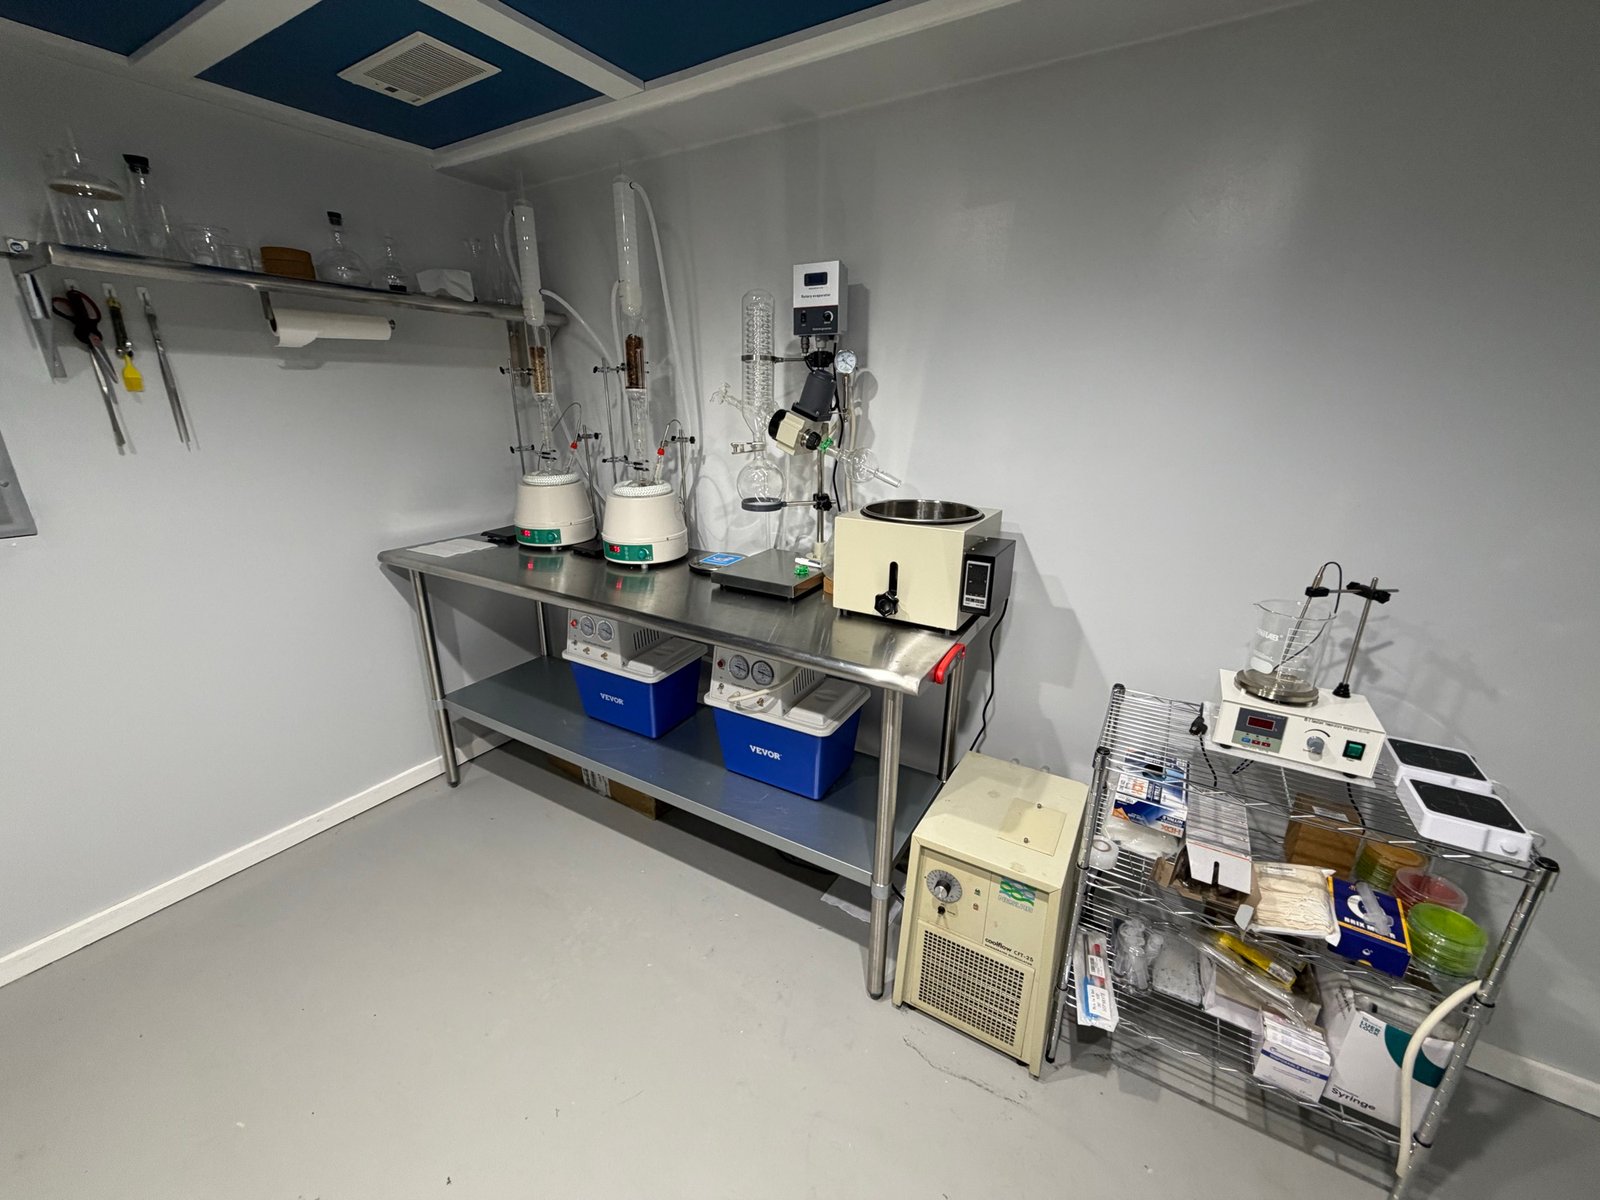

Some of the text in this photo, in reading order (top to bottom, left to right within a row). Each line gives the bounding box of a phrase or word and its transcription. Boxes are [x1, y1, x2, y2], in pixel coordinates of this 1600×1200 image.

[600, 692, 624, 705] VEVOR
[749, 744, 782, 760] VEVOR
[1161, 824, 1182, 835] HDX
[1344, 917, 1366, 929] BRIX
[1331, 1087, 1376, 1112] Syringe
